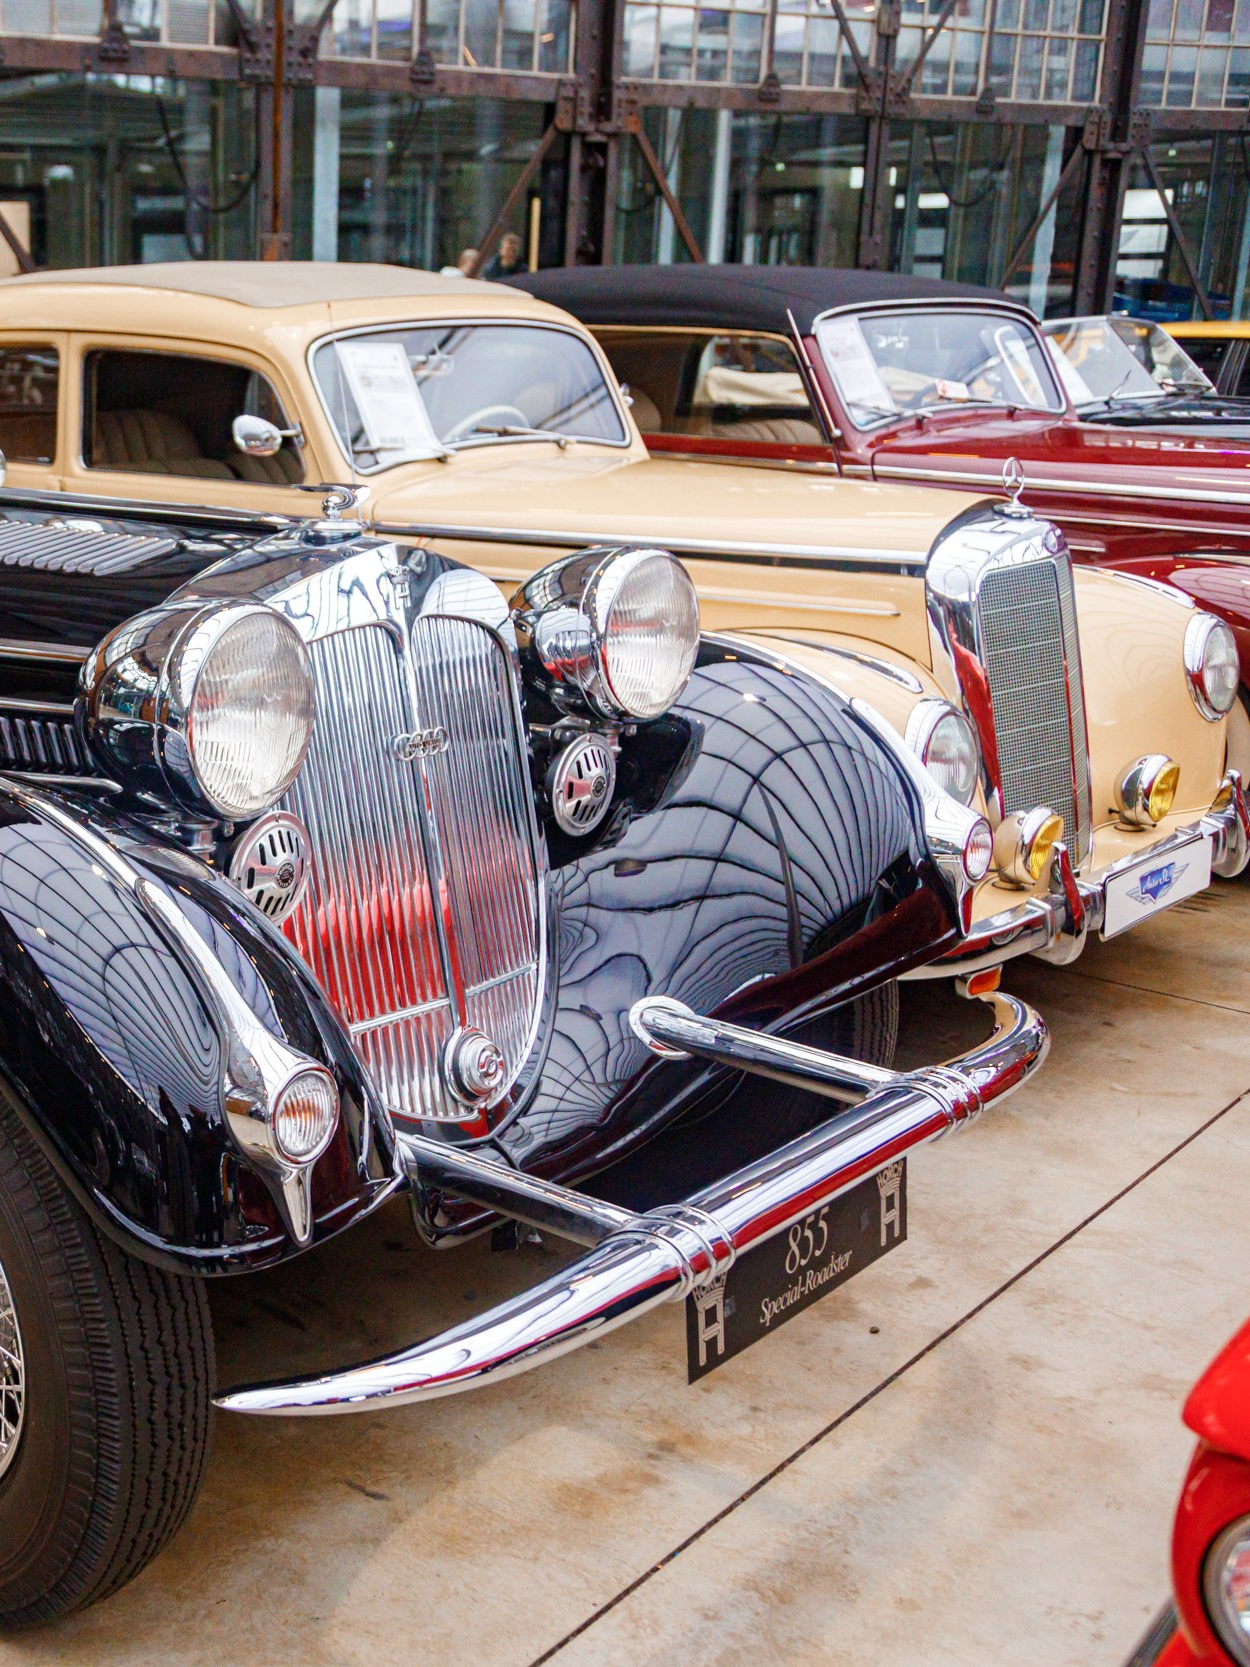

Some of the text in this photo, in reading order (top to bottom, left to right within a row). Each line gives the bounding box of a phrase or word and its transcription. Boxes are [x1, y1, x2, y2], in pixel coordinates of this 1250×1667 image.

[876, 1159, 904, 1188] HORCH
[785, 1205, 830, 1274] 855
[759, 1250, 853, 1327] Special-Roadster
